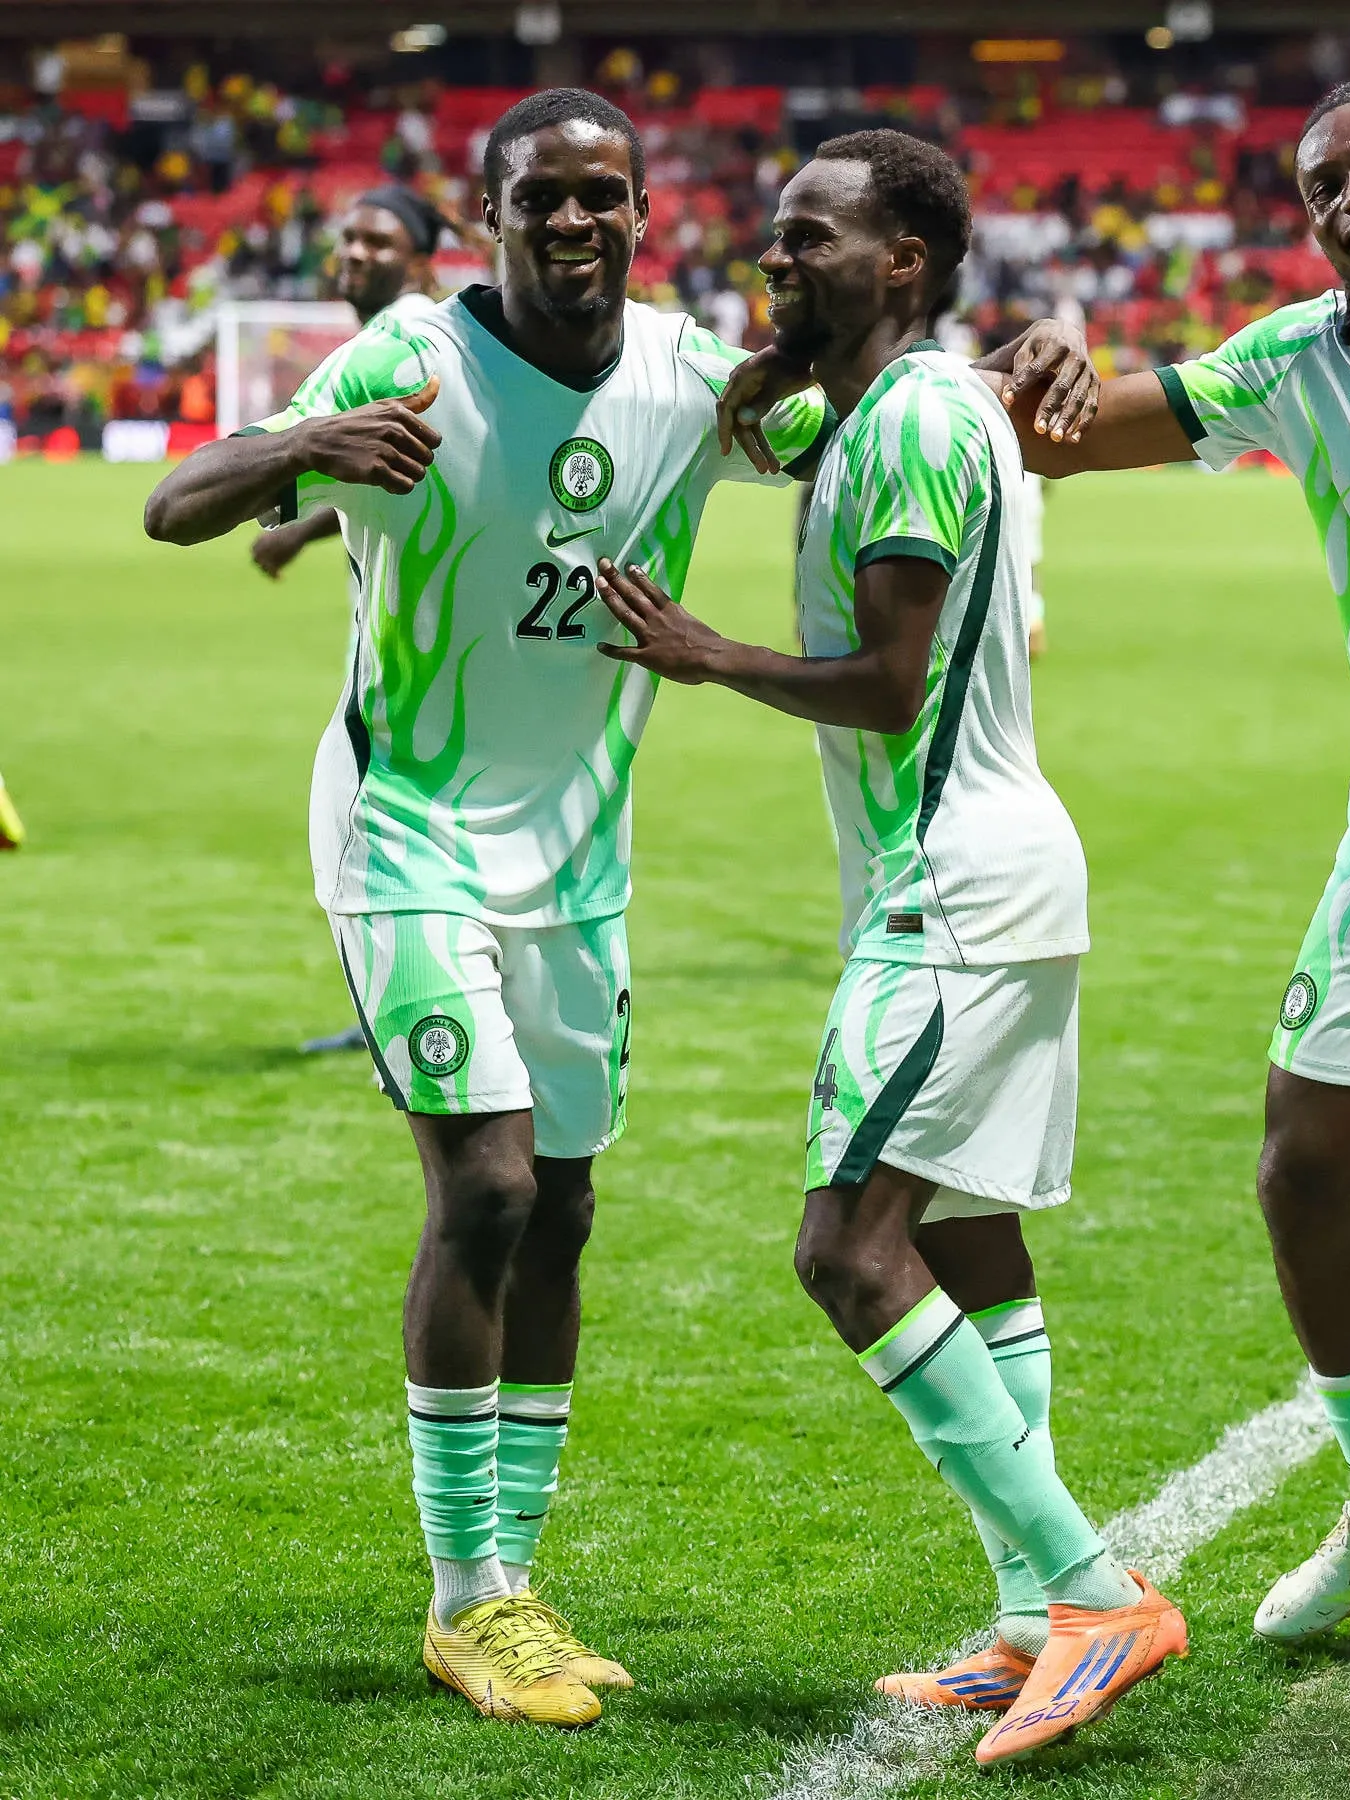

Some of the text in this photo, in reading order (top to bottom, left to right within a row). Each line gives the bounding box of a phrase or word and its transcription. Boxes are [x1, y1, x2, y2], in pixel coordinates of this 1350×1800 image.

[557, 441, 594, 460] FOOTBALL
[594, 448, 610, 498] FEDERATION
[516, 562, 598, 640] 22
[447, 1022, 465, 1063] FEDERATION
[814, 1028, 838, 1110] 4
[991, 1699, 1079, 1745] F50
